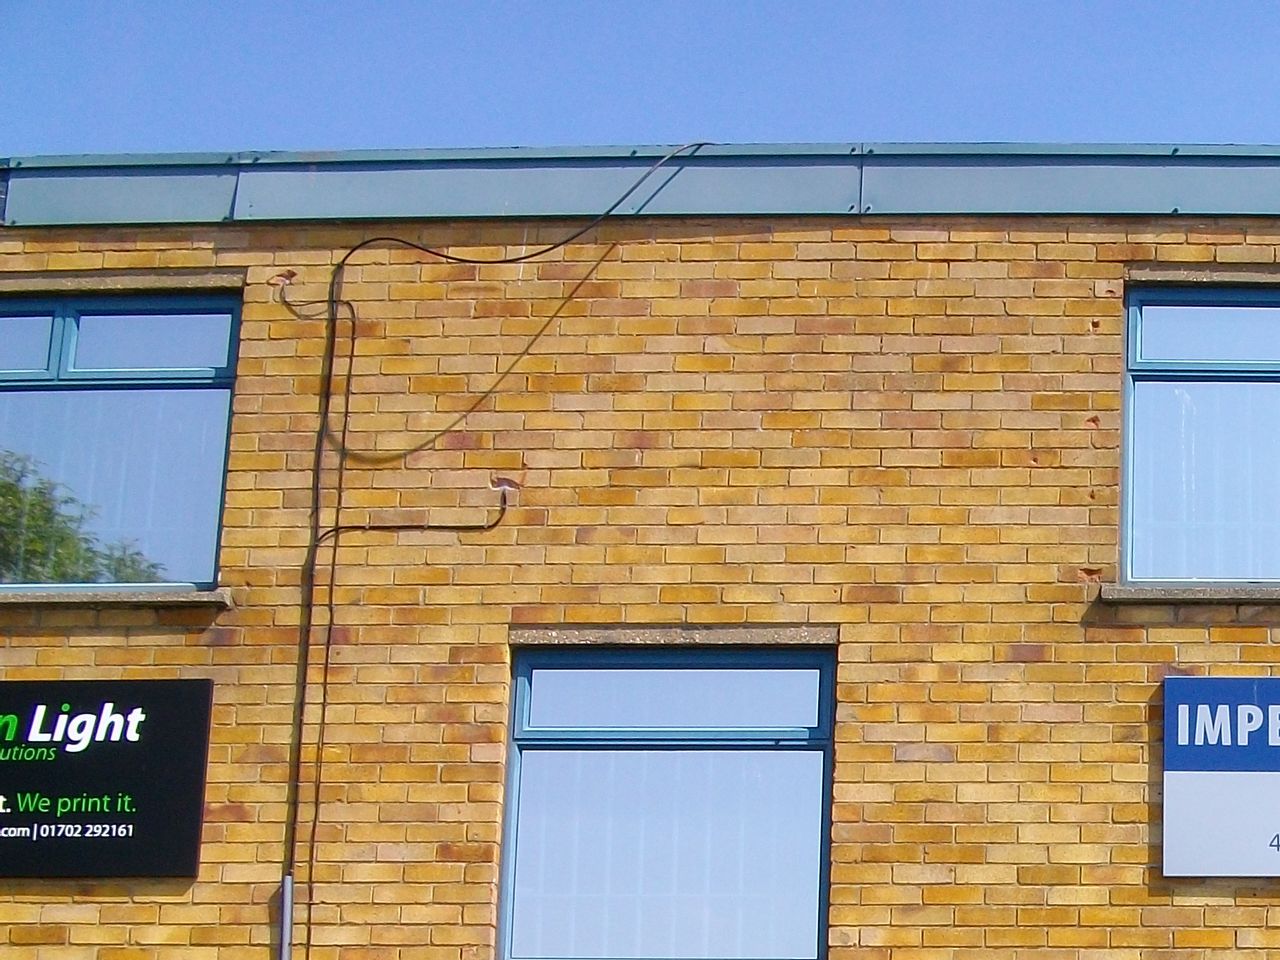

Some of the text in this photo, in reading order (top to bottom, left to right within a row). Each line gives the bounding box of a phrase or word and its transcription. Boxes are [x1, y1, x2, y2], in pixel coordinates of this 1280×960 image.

[28, 702, 146, 752] Light
[17, 792, 50, 812] We
[57, 792, 111, 817] print
[117, 792, 136, 812] it.
[40, 824, 82, 838] 01702
[85, 824, 134, 838] 292161
